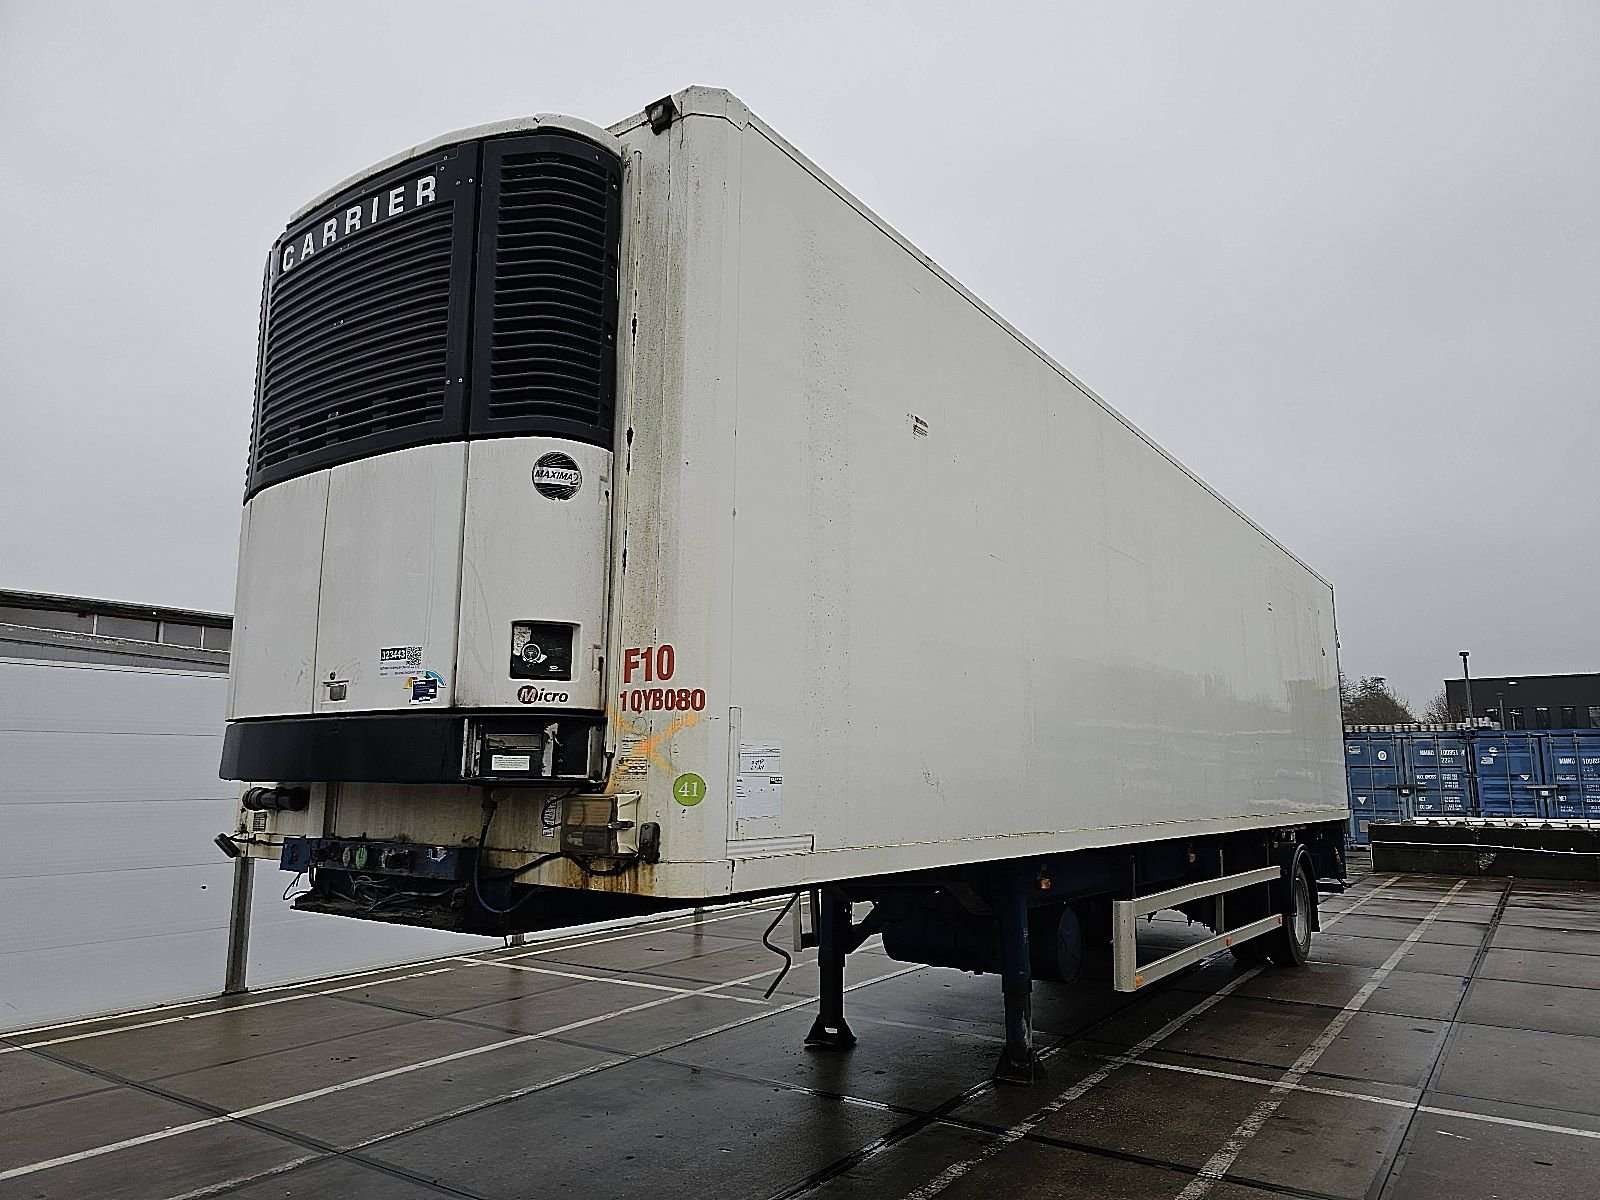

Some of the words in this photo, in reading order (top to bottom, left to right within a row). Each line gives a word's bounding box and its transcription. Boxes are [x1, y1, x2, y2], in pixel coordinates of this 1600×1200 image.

[282, 175, 436, 272] CARRIER
[623, 644, 675, 684] F10
[517, 685, 569, 704] Micro
[678, 781, 699, 798] 41
